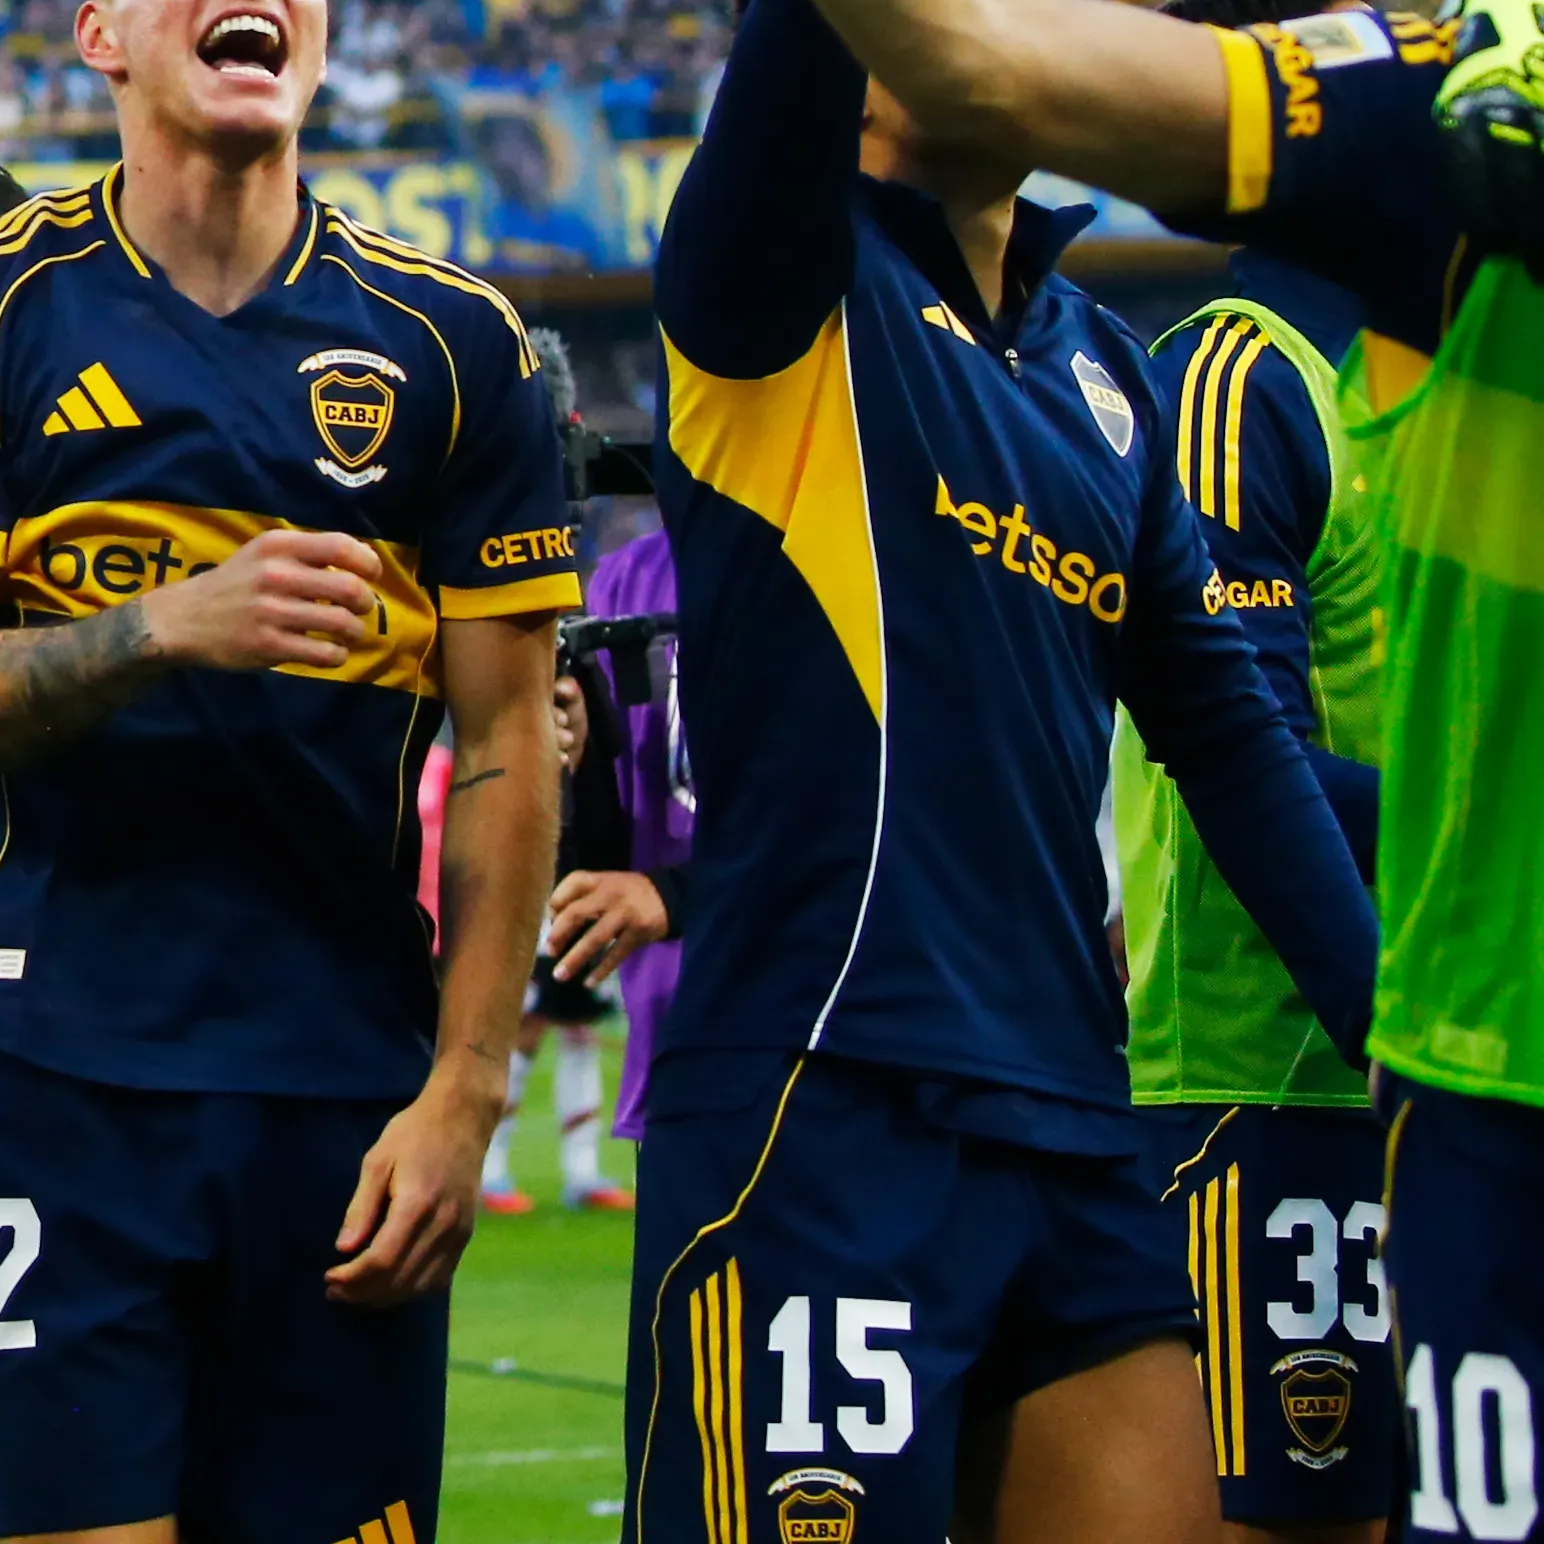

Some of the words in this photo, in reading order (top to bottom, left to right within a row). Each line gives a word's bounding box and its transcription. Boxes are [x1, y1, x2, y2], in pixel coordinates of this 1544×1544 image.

[325, 404, 380, 425] CABJ
[1266, 1198, 1392, 1343] 33
[766, 1296, 914, 1454] 15
[1404, 1342, 1540, 1543] 10
[791, 1522, 841, 1539] CABJ
